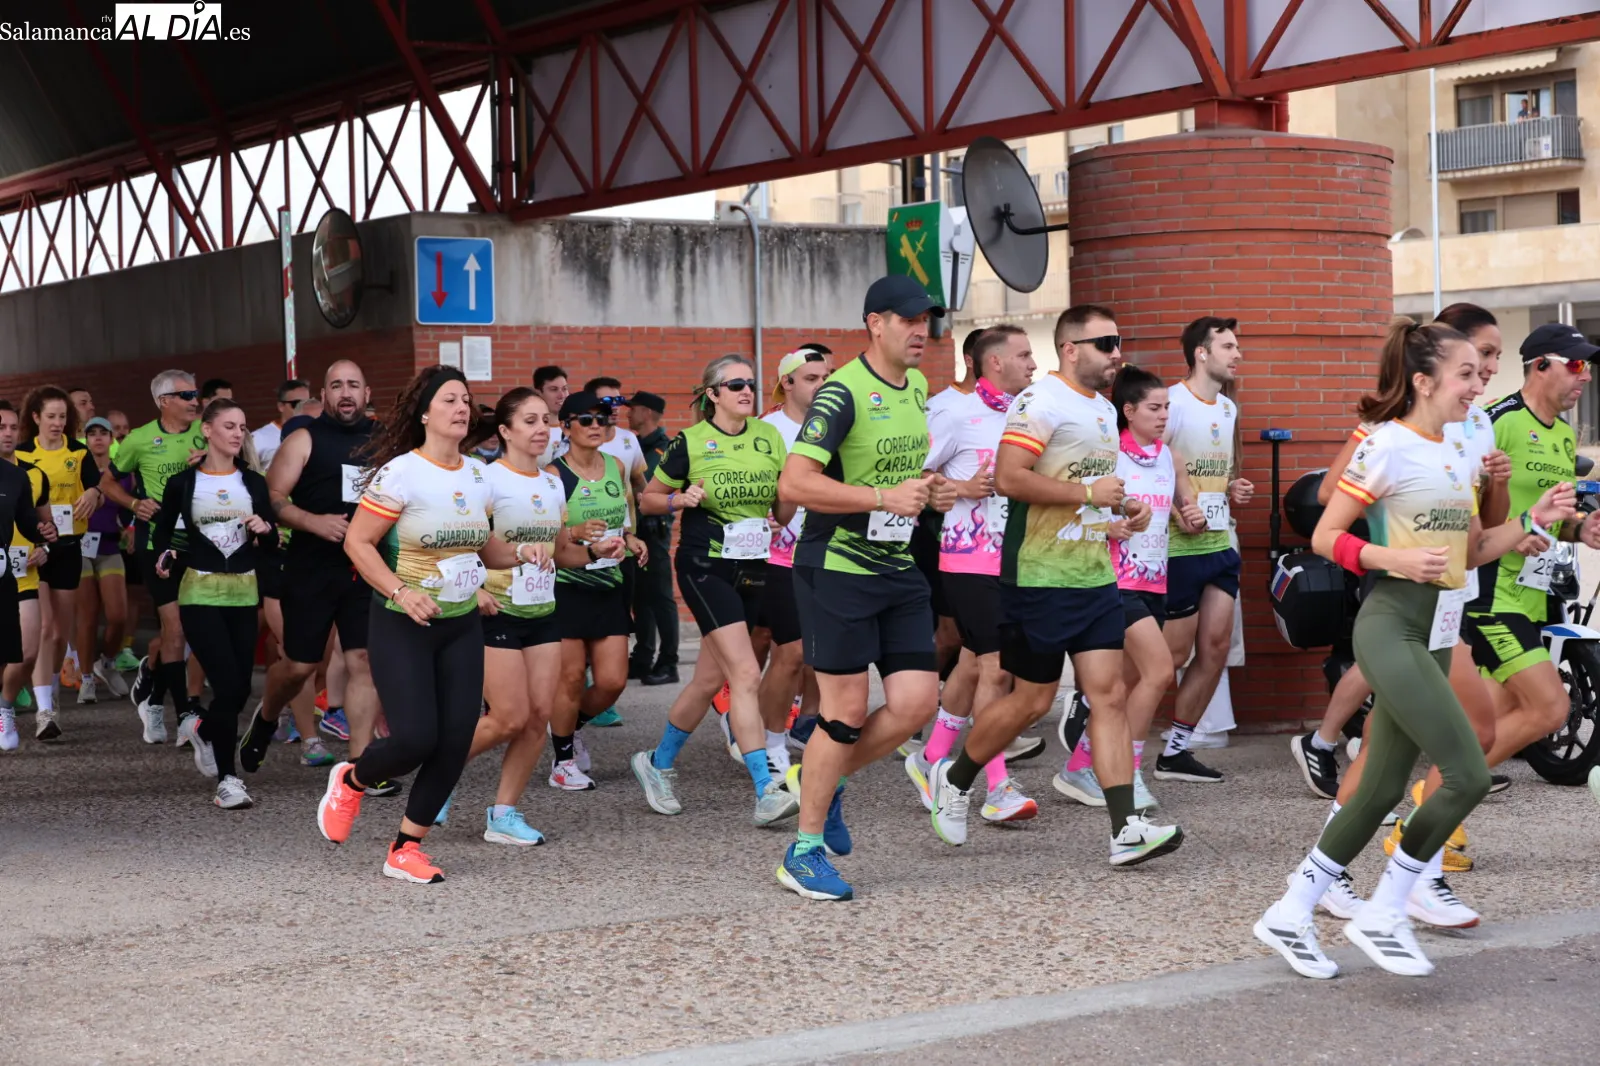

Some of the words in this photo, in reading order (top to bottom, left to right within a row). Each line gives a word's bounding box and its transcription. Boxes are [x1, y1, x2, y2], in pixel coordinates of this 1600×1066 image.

[1206, 505, 1225, 519] 571
[735, 532, 763, 548] 298
[454, 569, 479, 588] 476
[525, 575, 550, 592] 646
